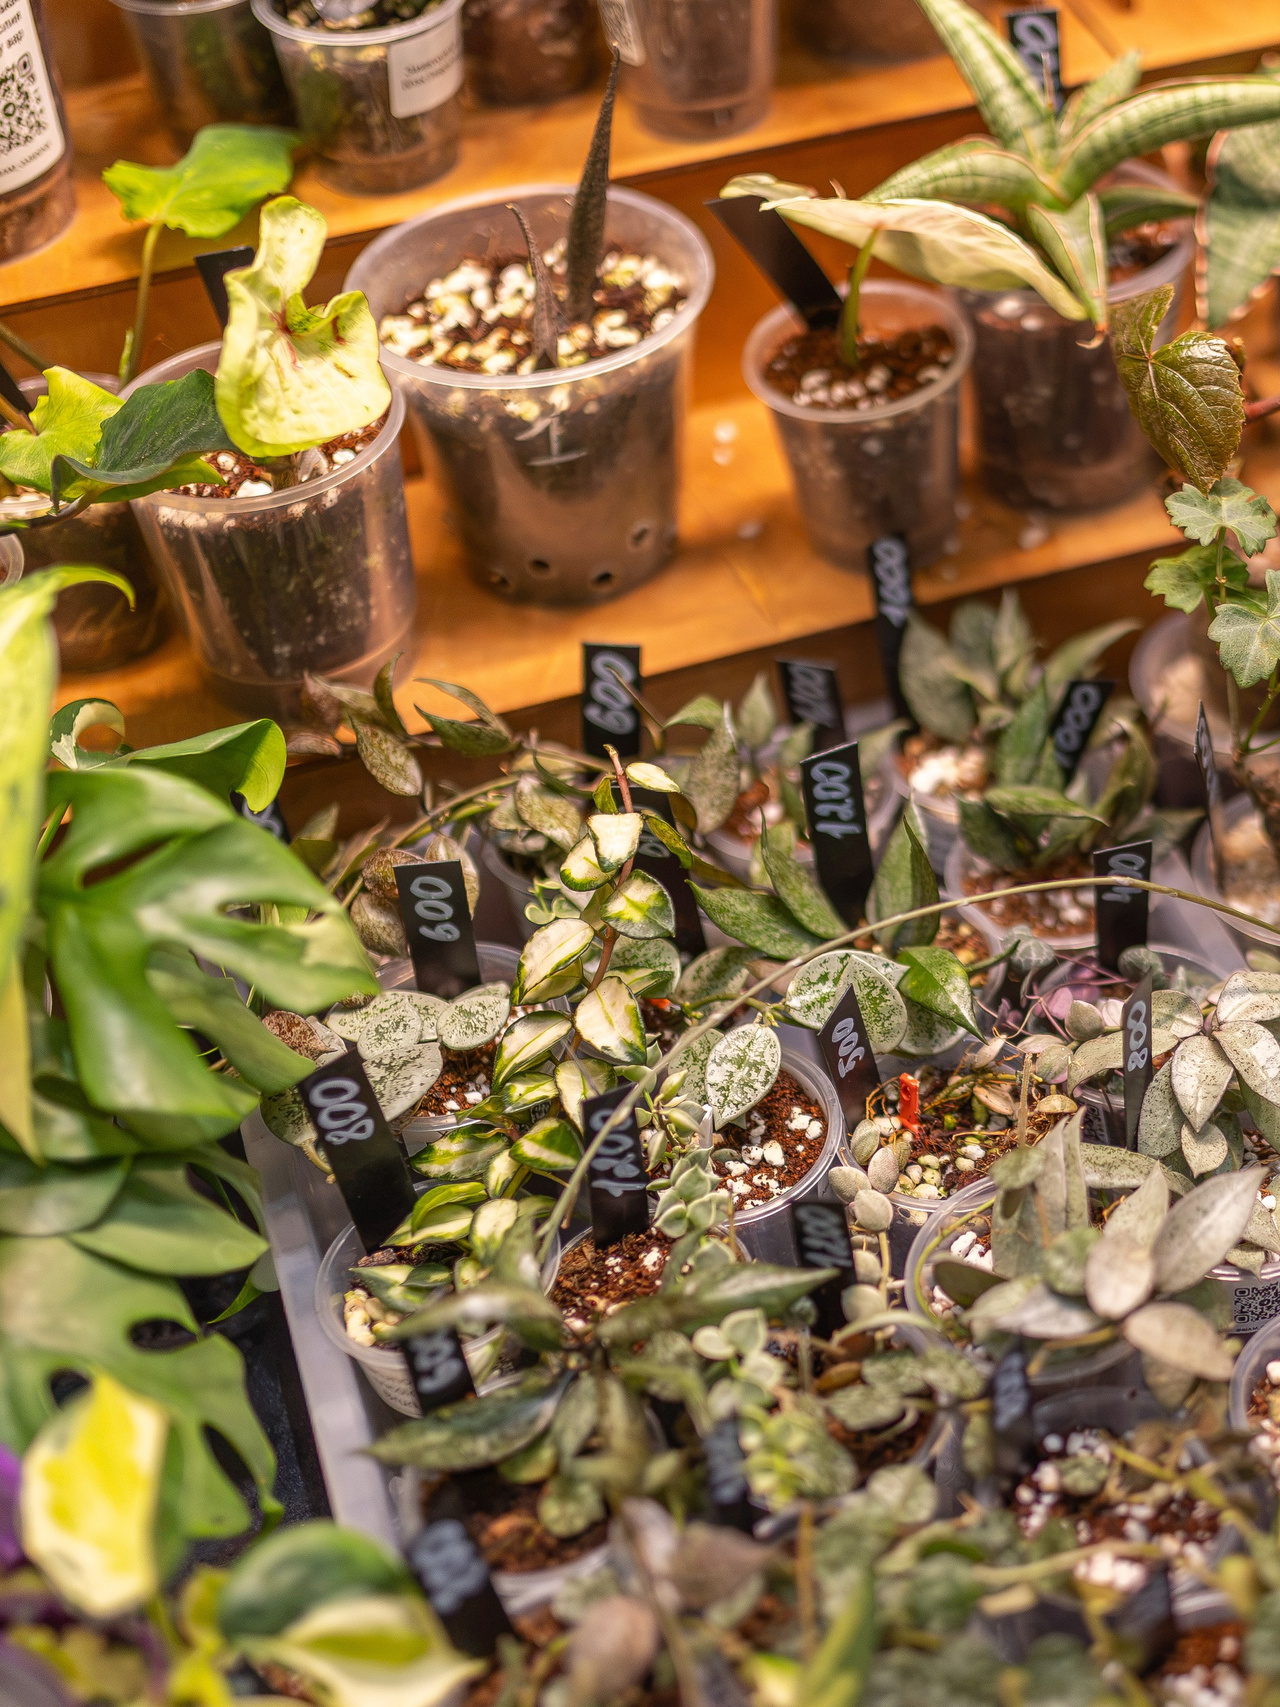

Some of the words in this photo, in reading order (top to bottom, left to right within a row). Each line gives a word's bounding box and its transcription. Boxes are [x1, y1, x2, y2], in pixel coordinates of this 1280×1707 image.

[583, 651, 638, 735] 600
[810, 761, 862, 840] 1200
[410, 875, 460, 942] 600
[831, 1017, 864, 1078] 500
[1127, 1000, 1147, 1072] 800
[310, 1077, 375, 1146] 800
[590, 1108, 649, 1197] 1200
